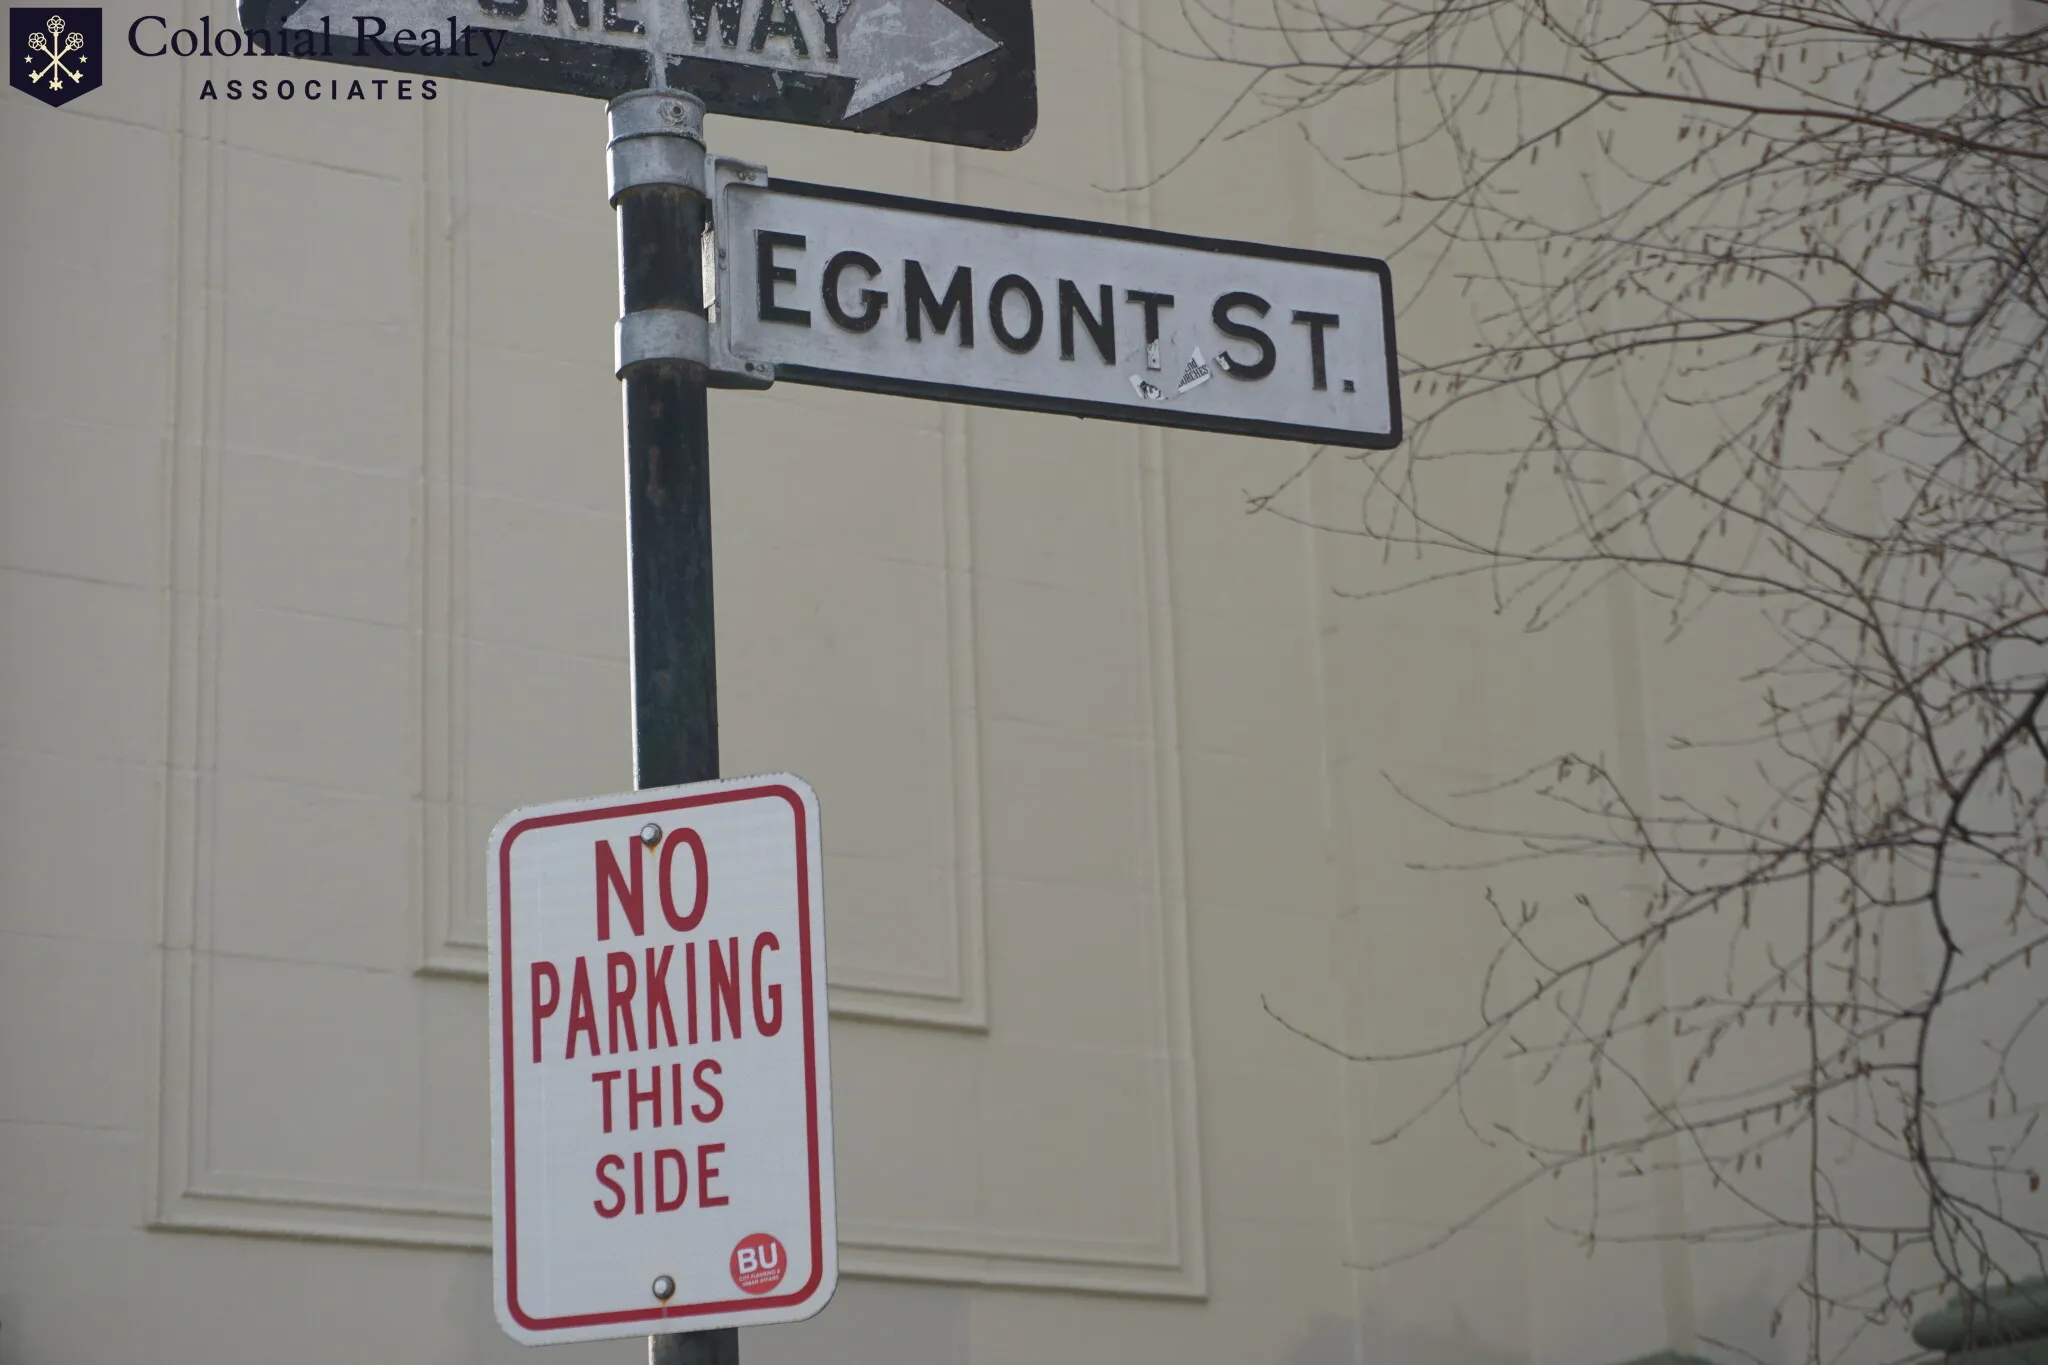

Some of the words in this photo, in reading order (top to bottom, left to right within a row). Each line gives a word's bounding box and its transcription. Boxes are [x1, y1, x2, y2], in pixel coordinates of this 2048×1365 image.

[686, 0, 852, 60] WAY
[754, 228, 1175, 371] EGMONT
[1211, 290, 1356, 395] ST.
[595, 827, 709, 941] NO
[530, 931, 783, 1064] PARKING
[592, 1058, 724, 1134] THIS
[593, 1142, 729, 1219] SIDE
[737, 1242, 778, 1274] BU
